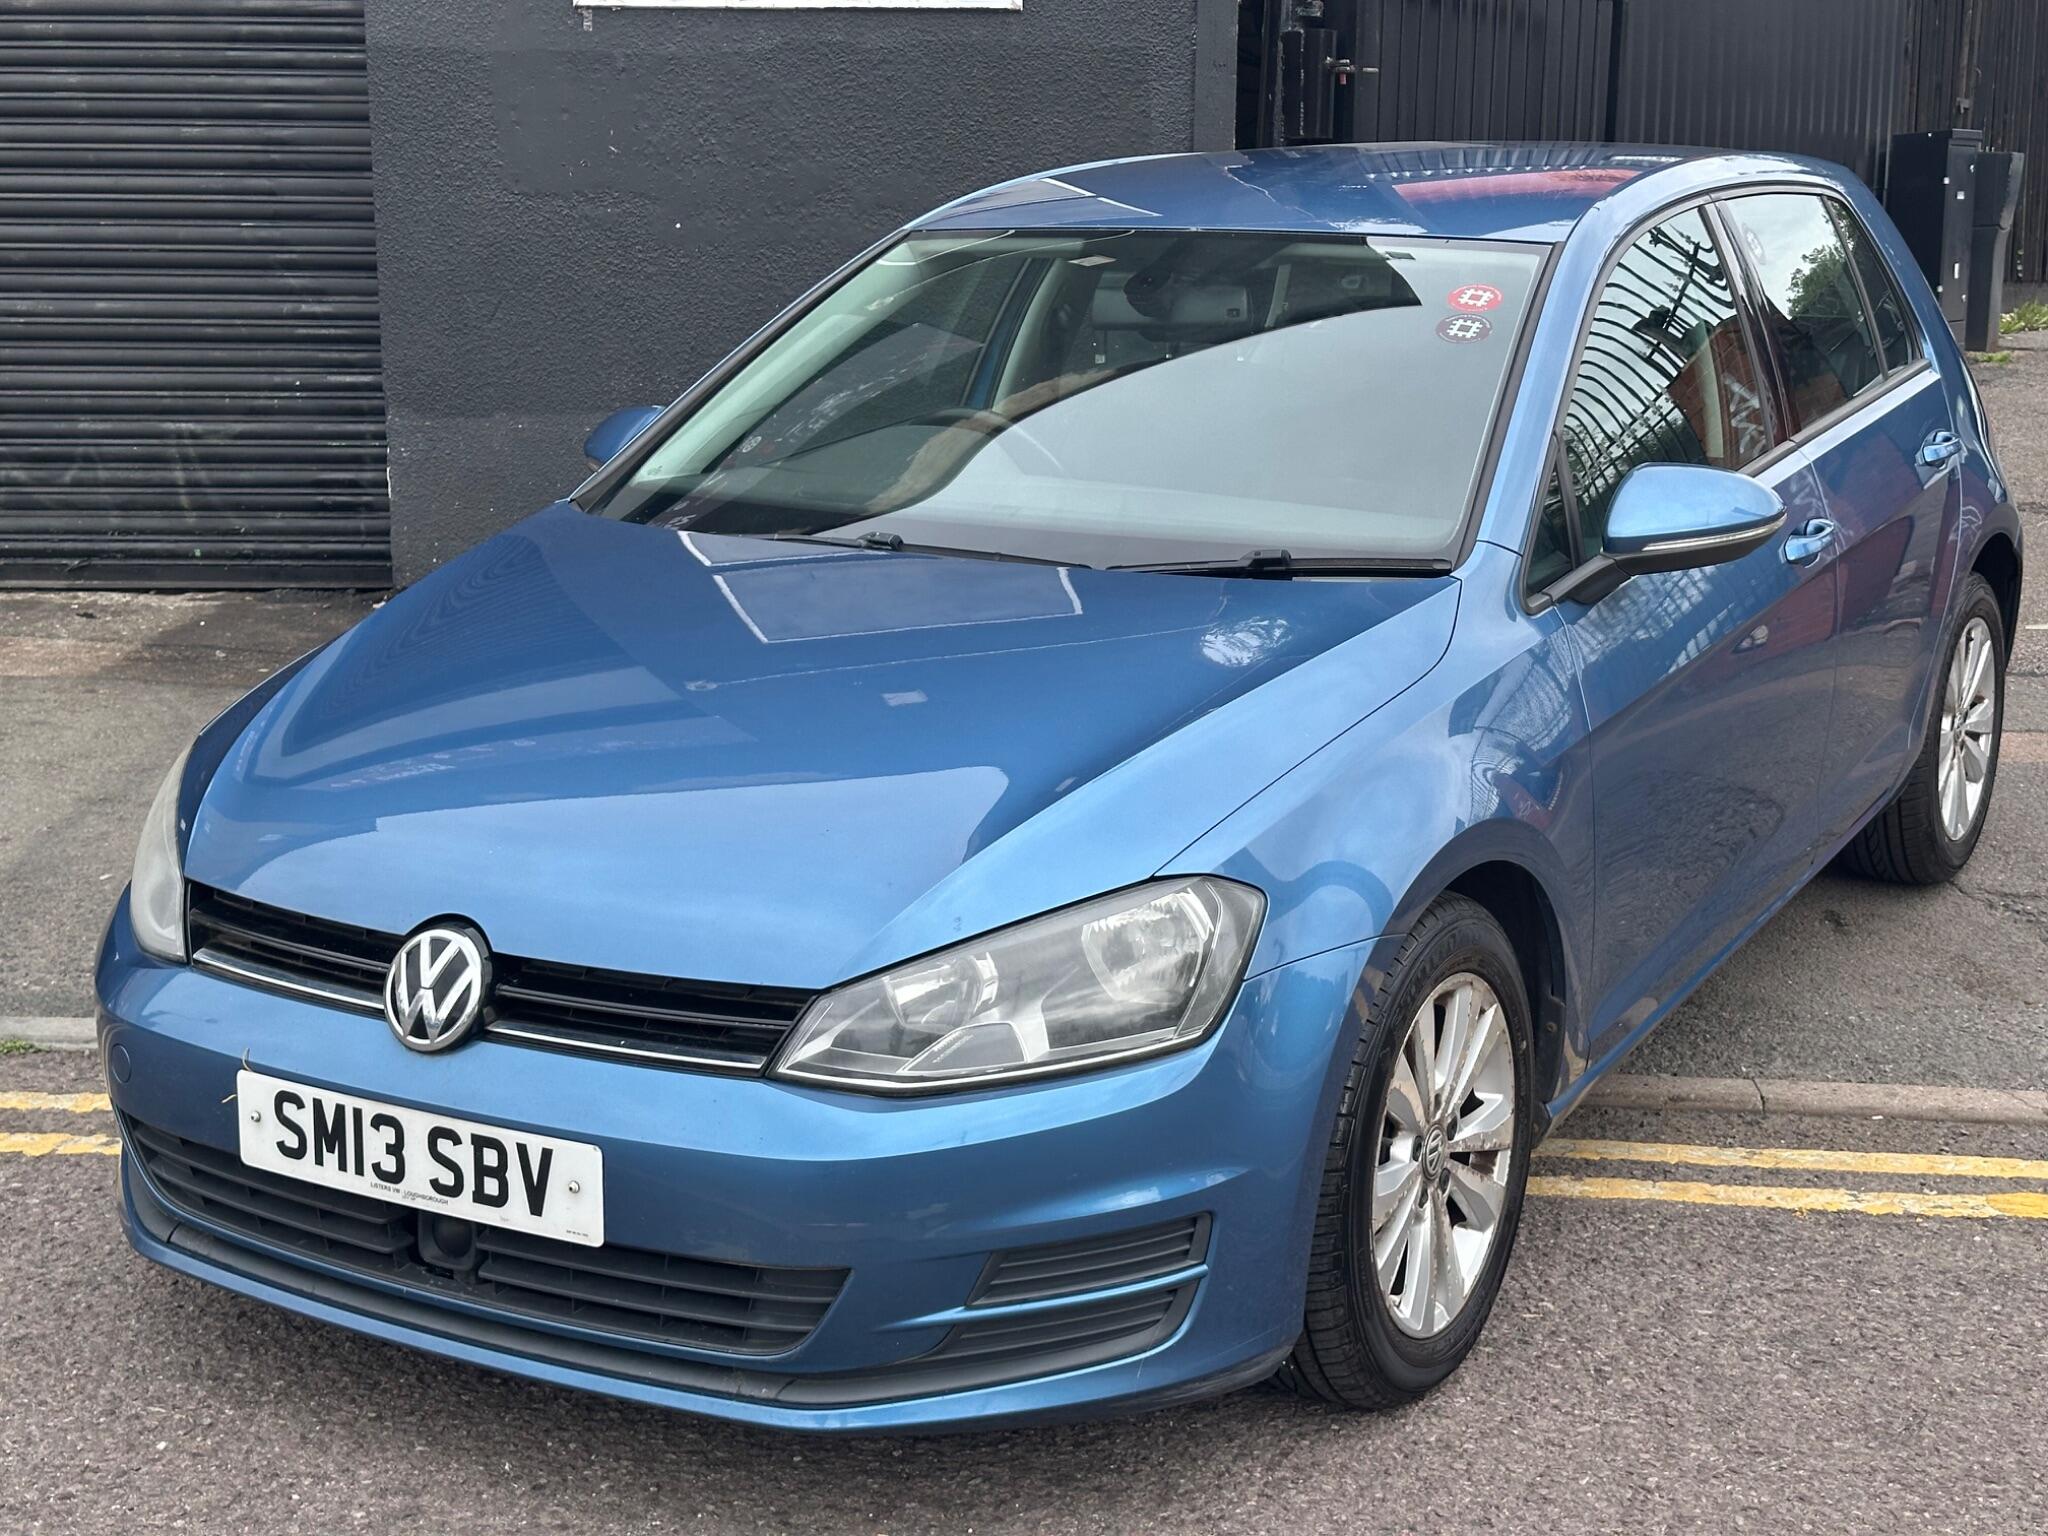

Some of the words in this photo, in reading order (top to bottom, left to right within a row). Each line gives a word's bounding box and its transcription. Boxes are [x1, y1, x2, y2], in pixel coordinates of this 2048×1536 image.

[273, 1089, 406, 1185] SM13
[427, 1125, 554, 1217] SBV
[403, 1190, 448, 1205] LOUGHBOROUGH
